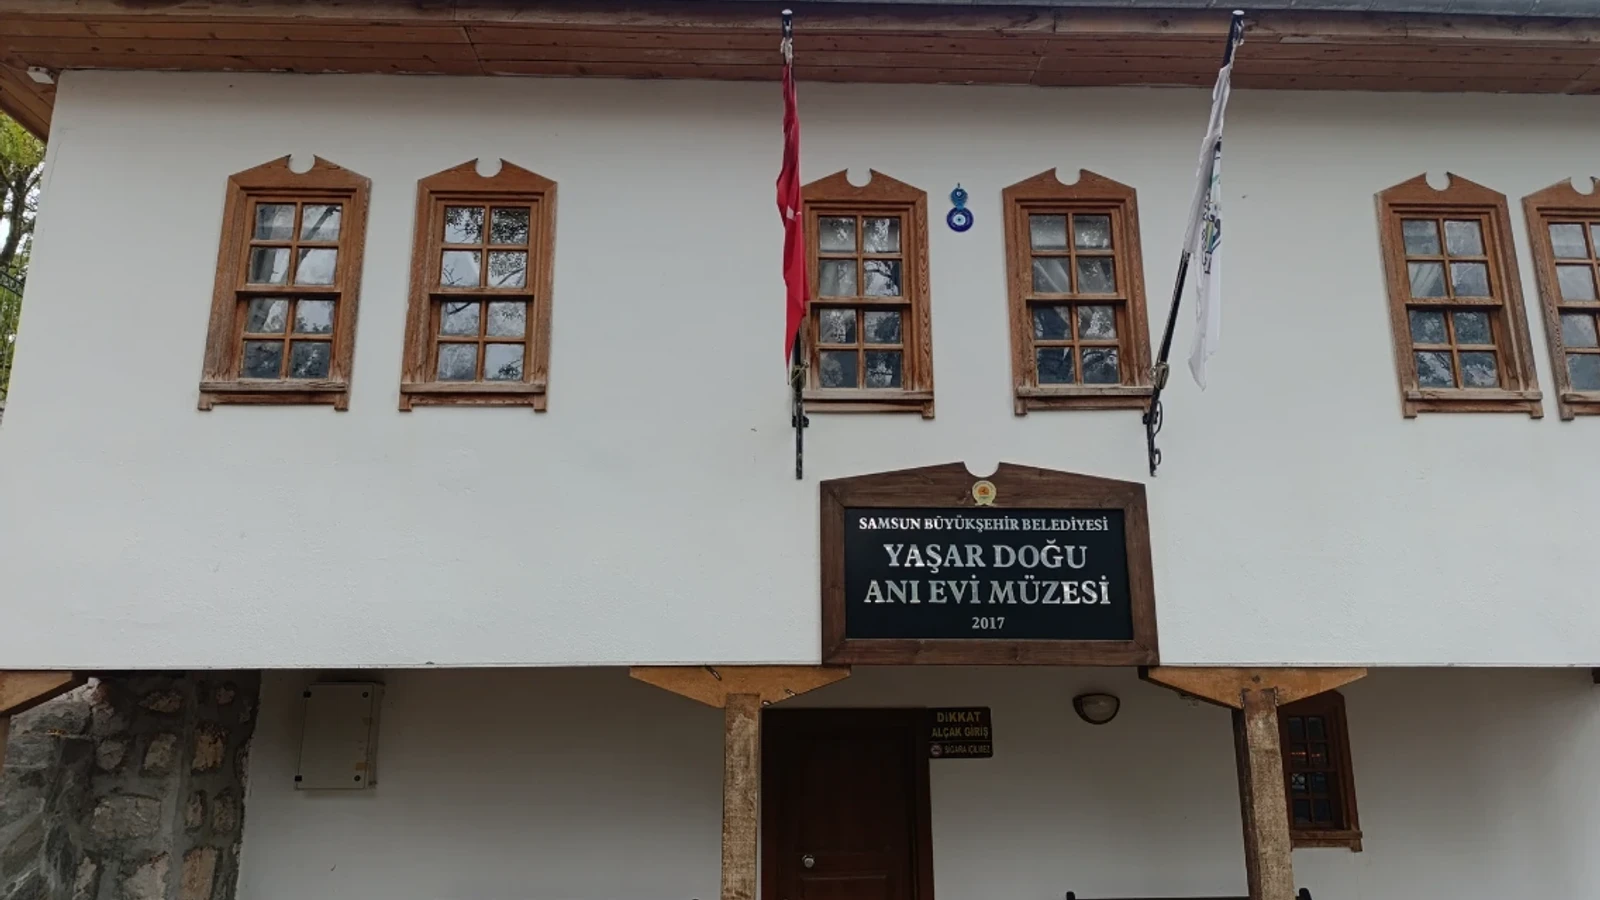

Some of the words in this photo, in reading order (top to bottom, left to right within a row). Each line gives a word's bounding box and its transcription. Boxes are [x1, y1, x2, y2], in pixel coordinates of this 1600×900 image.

[859, 517, 921, 531] SAMSUN
[924, 515, 1019, 533] BÜYÜKŞEHİR
[1022, 516, 1109, 532] BELEDİYESİ
[883, 543, 986, 573] YAŞAR
[993, 539, 1087, 569] DOĞU
[864, 580, 920, 603] ANI
[928, 575, 981, 604] EVİ
[988, 575, 1111, 605] MÜZESİ
[971, 617, 1006, 630] 2017
[932, 727, 962, 739] ALÇAK
[964, 725, 989, 739] GİRİŞ
